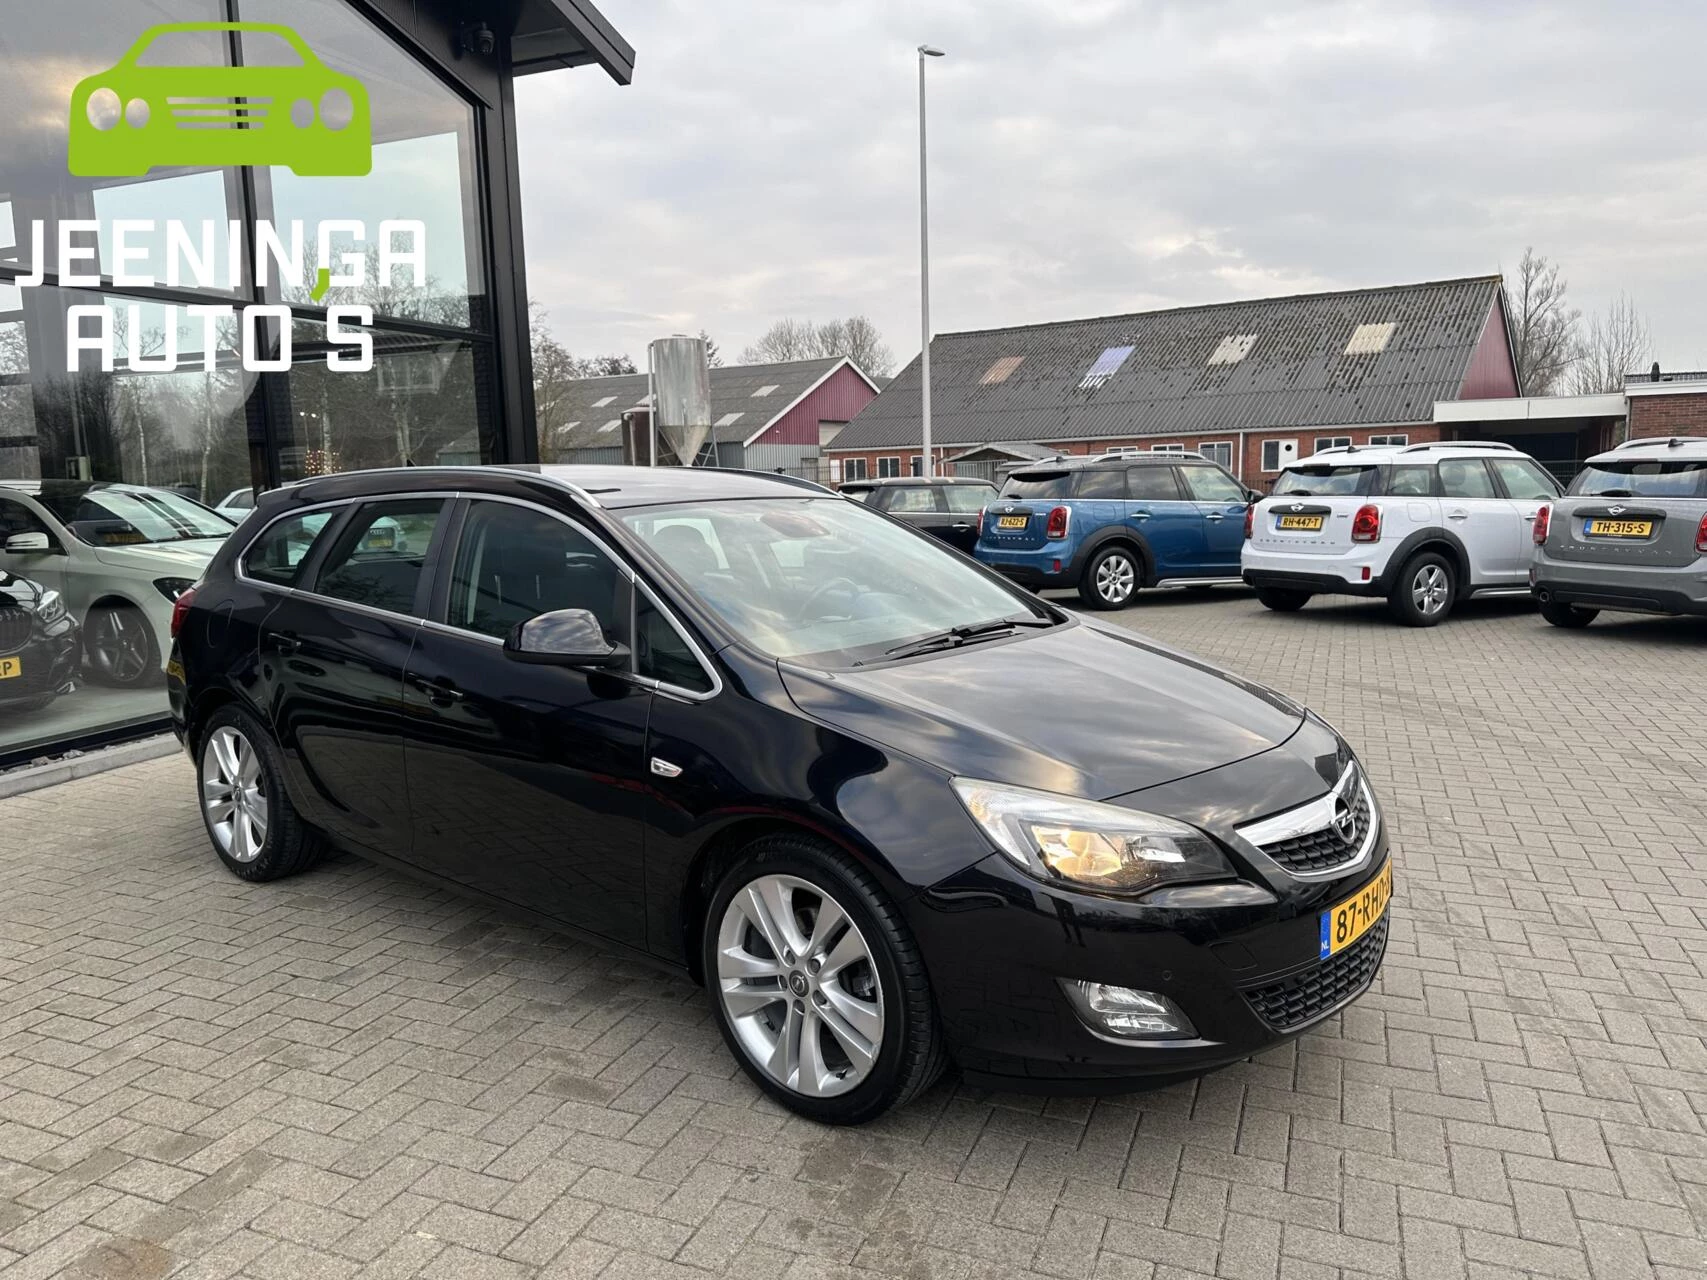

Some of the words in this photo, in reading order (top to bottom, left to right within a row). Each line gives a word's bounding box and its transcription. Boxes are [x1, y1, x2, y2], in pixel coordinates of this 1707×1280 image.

[1282, 515, 1319, 528] RH-447-T
[1596, 522, 1645, 534] TH-315-S
[1321, 940, 1329, 952] NL
